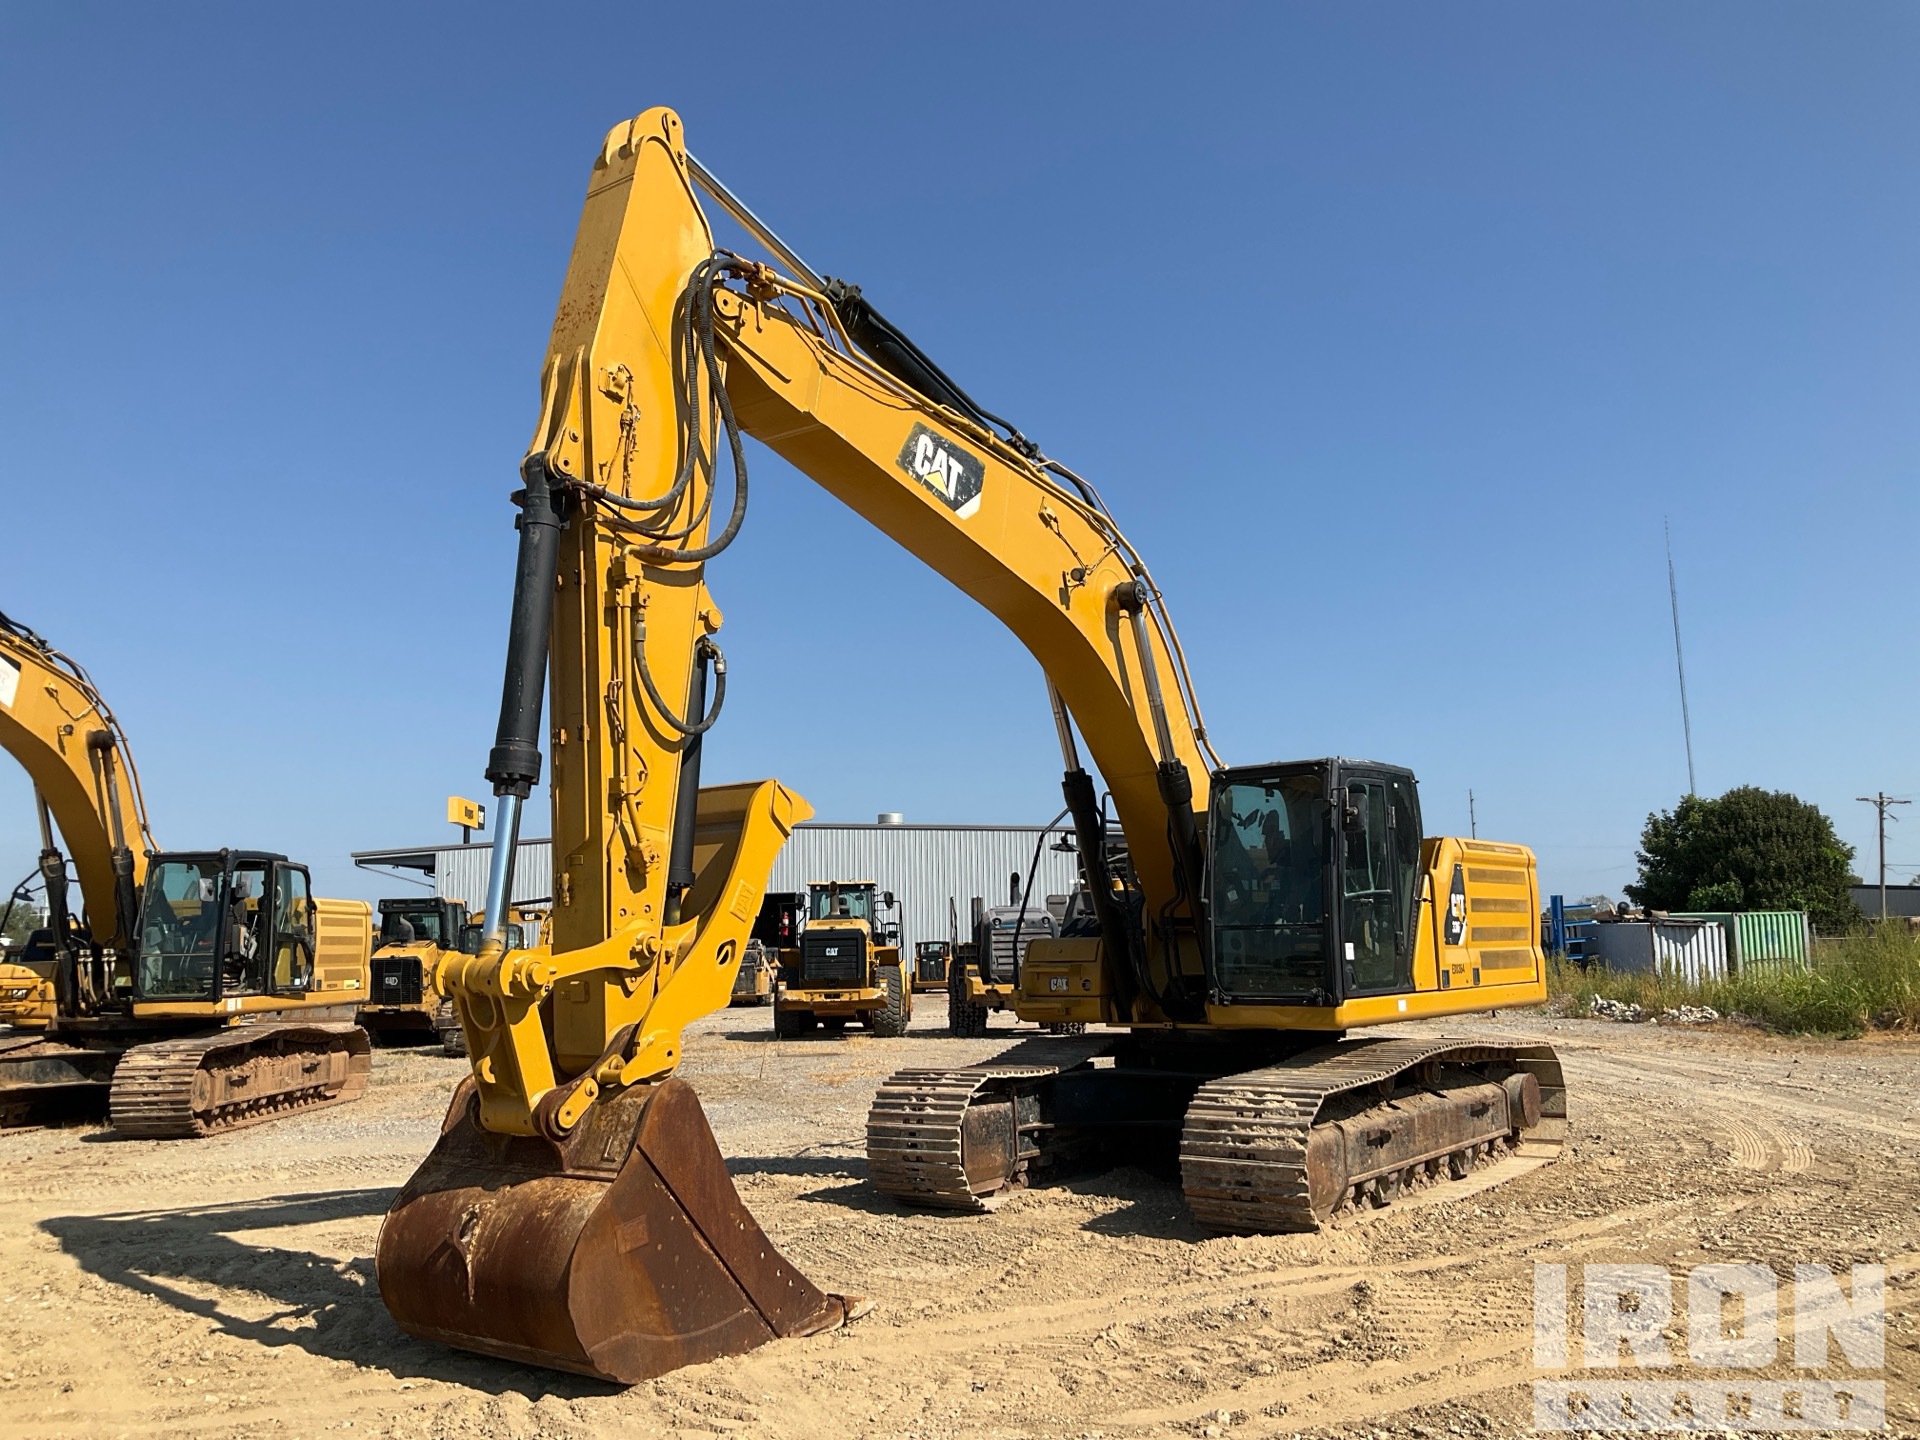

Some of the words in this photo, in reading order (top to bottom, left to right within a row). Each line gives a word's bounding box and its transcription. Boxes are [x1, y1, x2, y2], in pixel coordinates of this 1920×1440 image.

[915, 433, 964, 501] CAT
[825, 947, 839, 956] CAT
[1050, 978, 1068, 991] CAT
